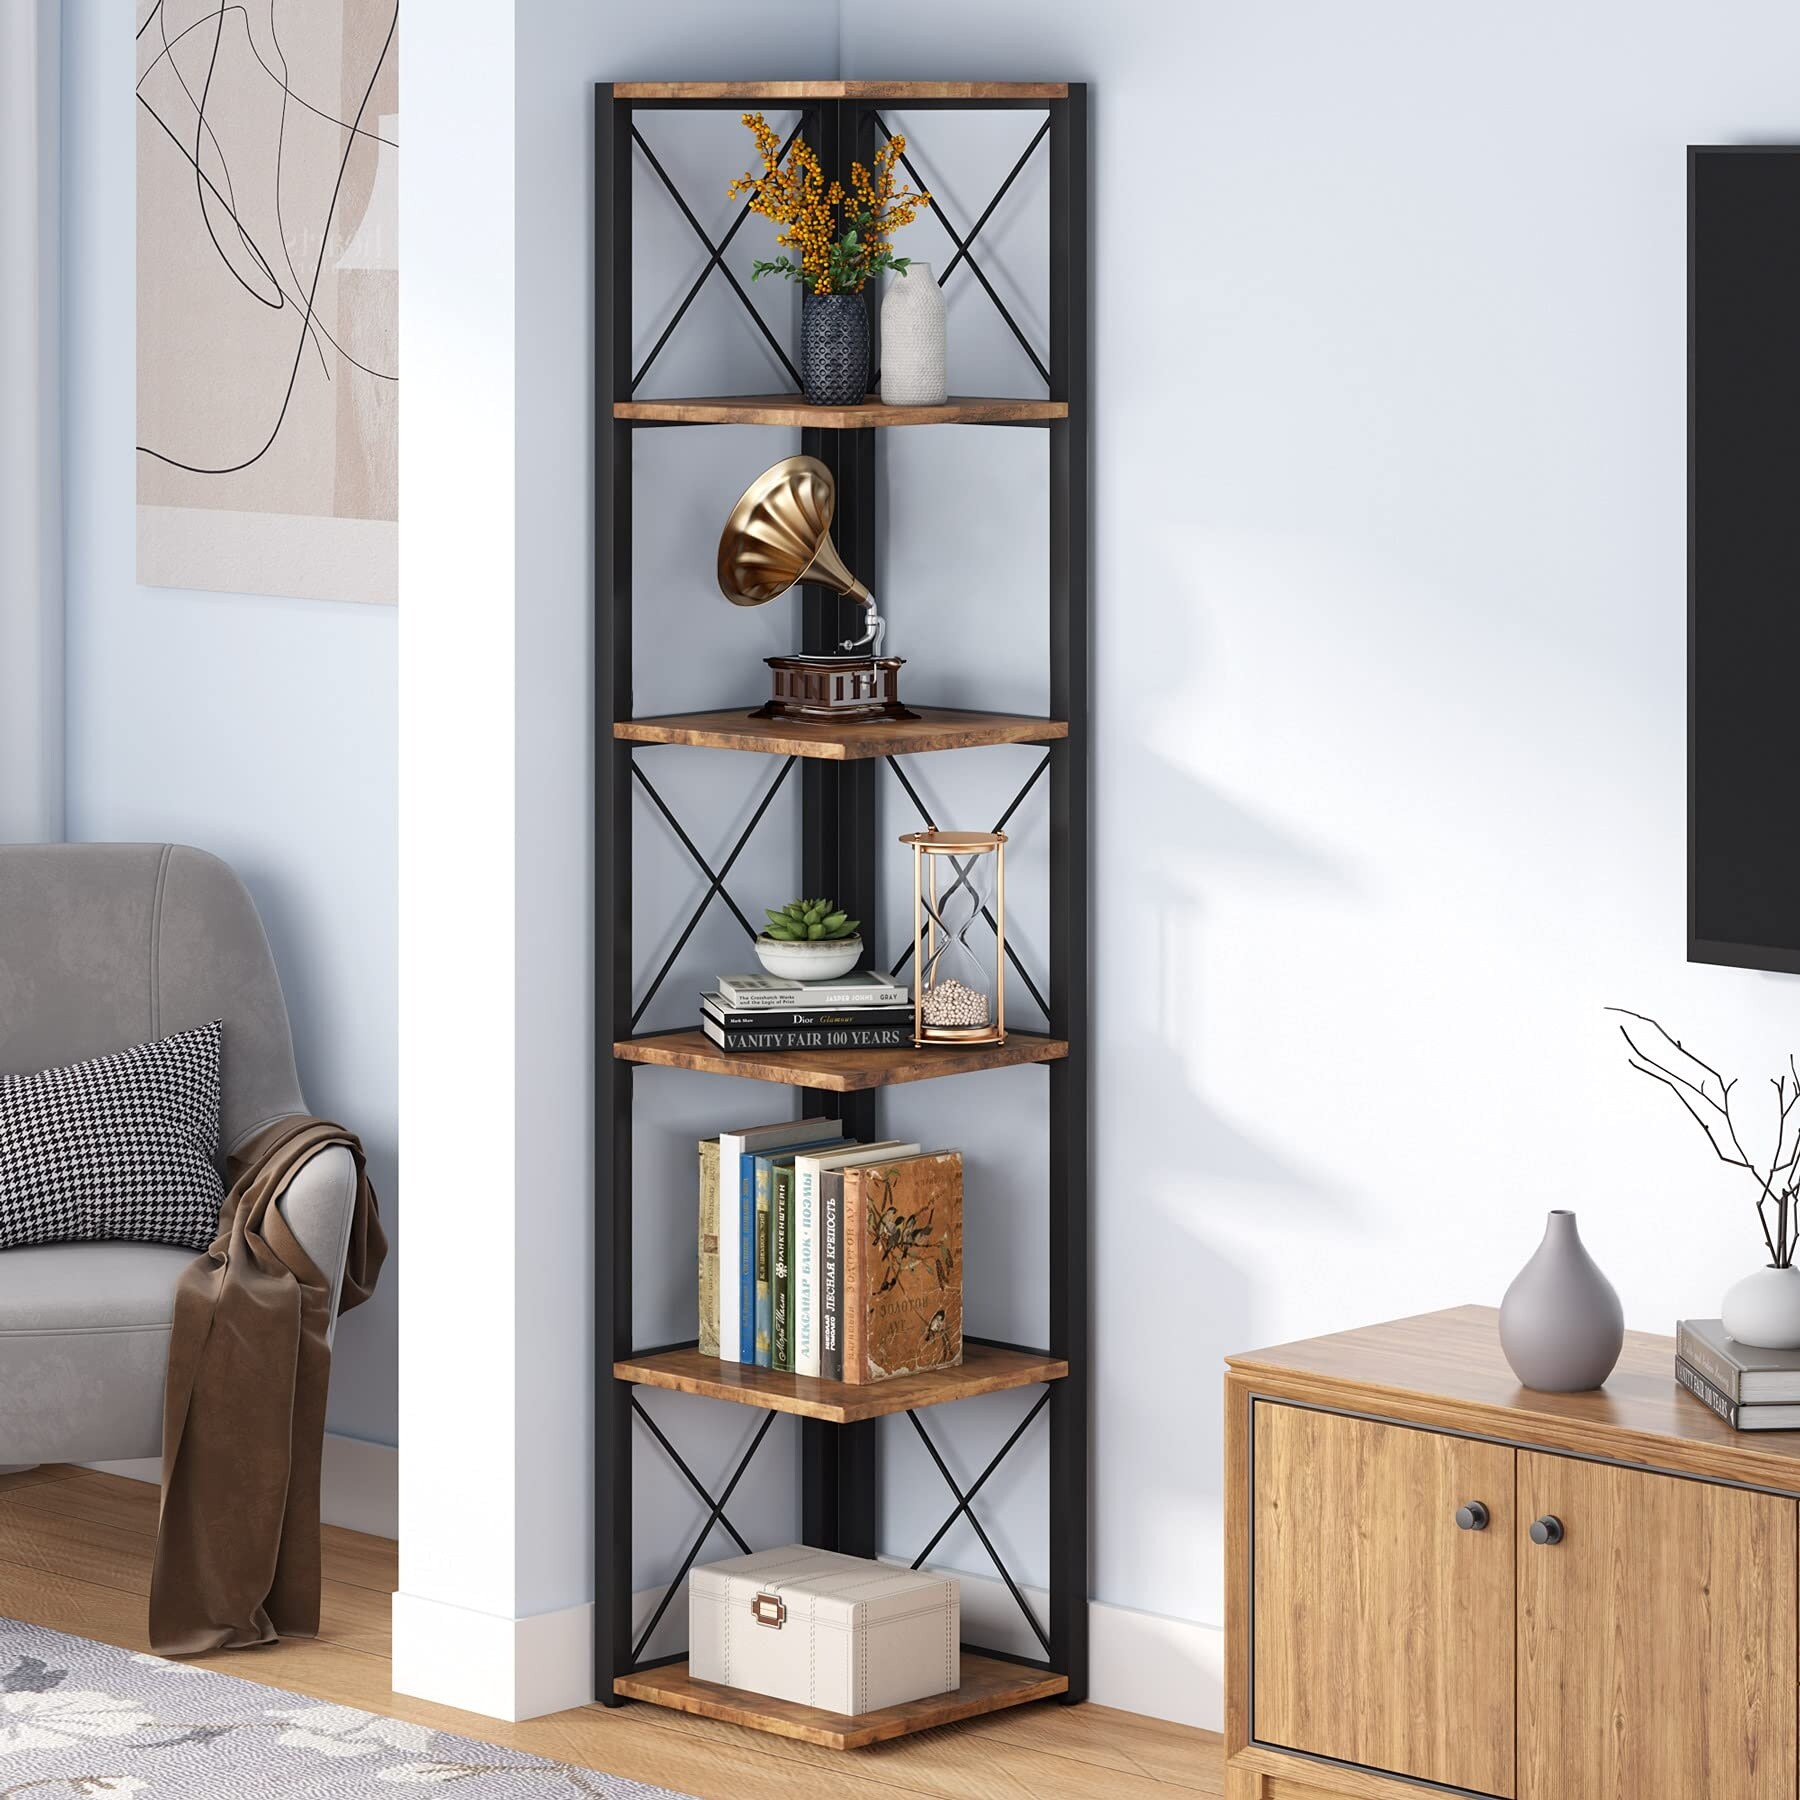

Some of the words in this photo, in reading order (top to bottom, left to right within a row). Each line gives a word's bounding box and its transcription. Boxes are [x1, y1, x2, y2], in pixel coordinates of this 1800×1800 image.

[825, 994, 850, 1002] JASPER
[793, 1014, 814, 1024] Dior
[820, 1015, 853, 1023] Glamour
[727, 1032, 784, 1048] VANITY
[787, 1031, 822, 1047] FAIR
[827, 1031, 848, 1045] 100
[852, 1030, 900, 1044] YEARS
[803, 1173, 813, 1228] ПОЭМЫ
[826, 1198, 836, 1259] КРЕПОСТЬ
[802, 1238, 812, 1274] БЛОК
[826, 1262, 836, 1312] ЛЕСНАЯ
[801, 1279, 811, 1358] АЛЕКСАНДР
[1712, 1391, 1728, 1419] YEARS
